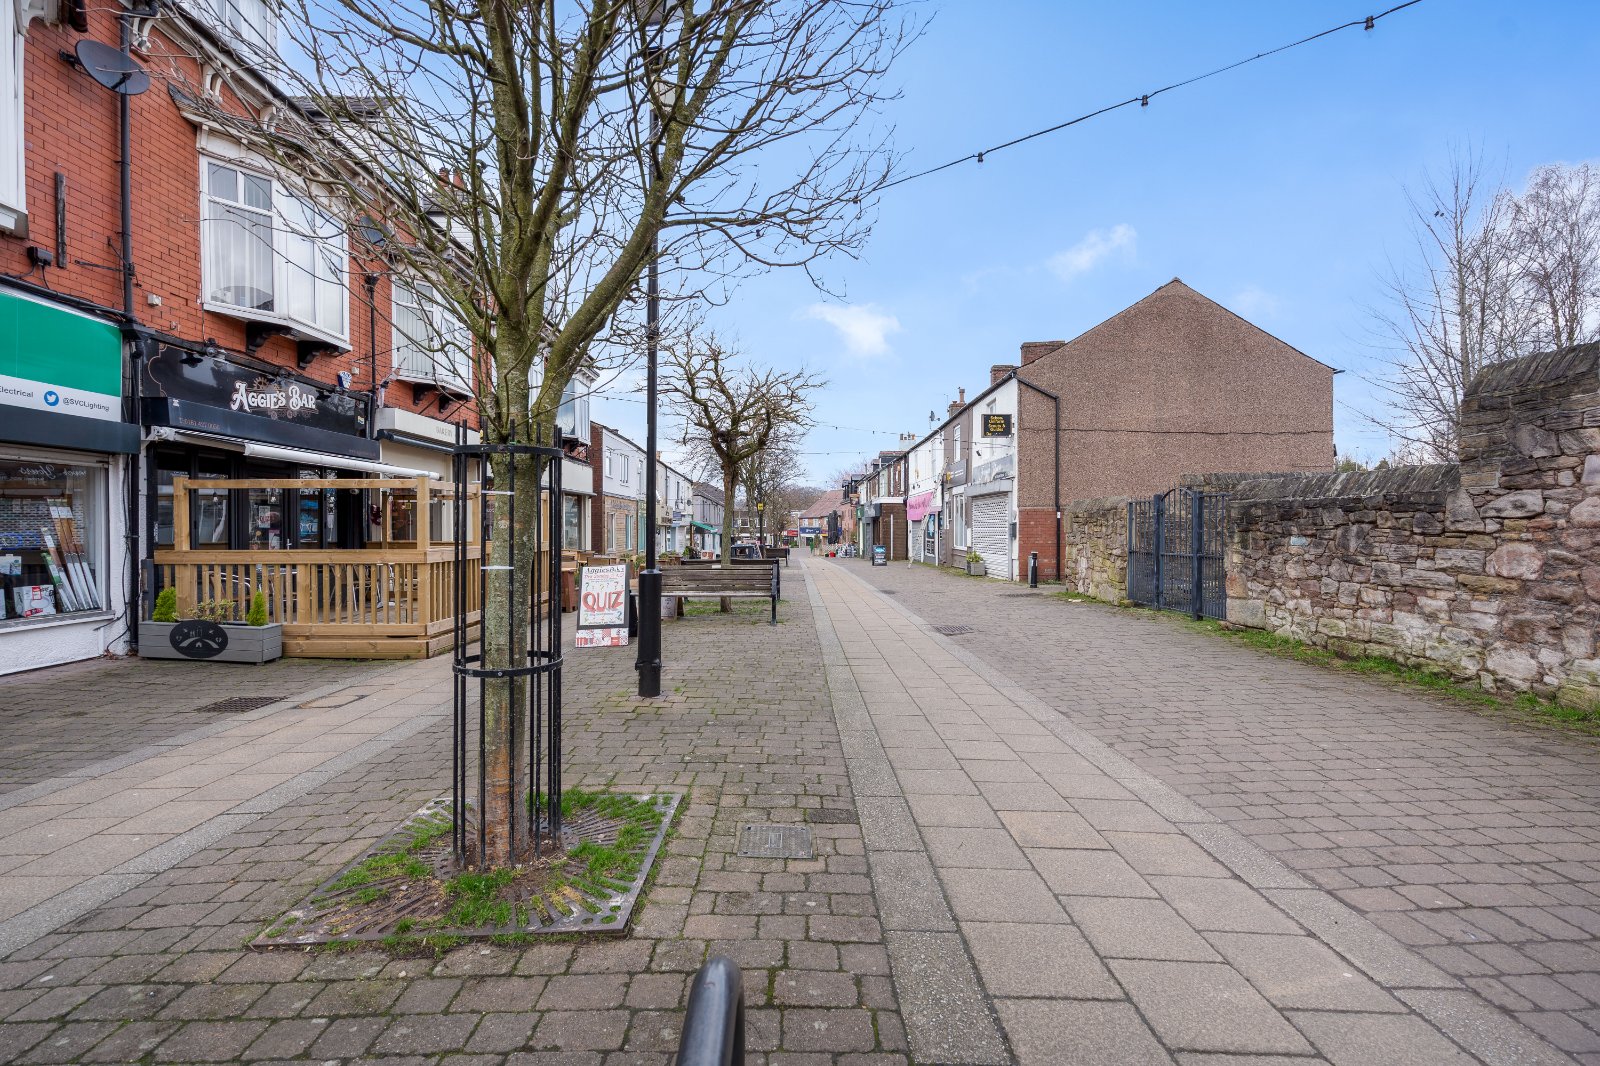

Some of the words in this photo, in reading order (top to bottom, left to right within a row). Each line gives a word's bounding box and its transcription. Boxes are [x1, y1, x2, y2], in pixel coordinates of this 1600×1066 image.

[0, 386, 34, 397] Electrical
[62, 397, 110, 412] @SVCLighting
[582, 590, 624, 612] QUIZ
